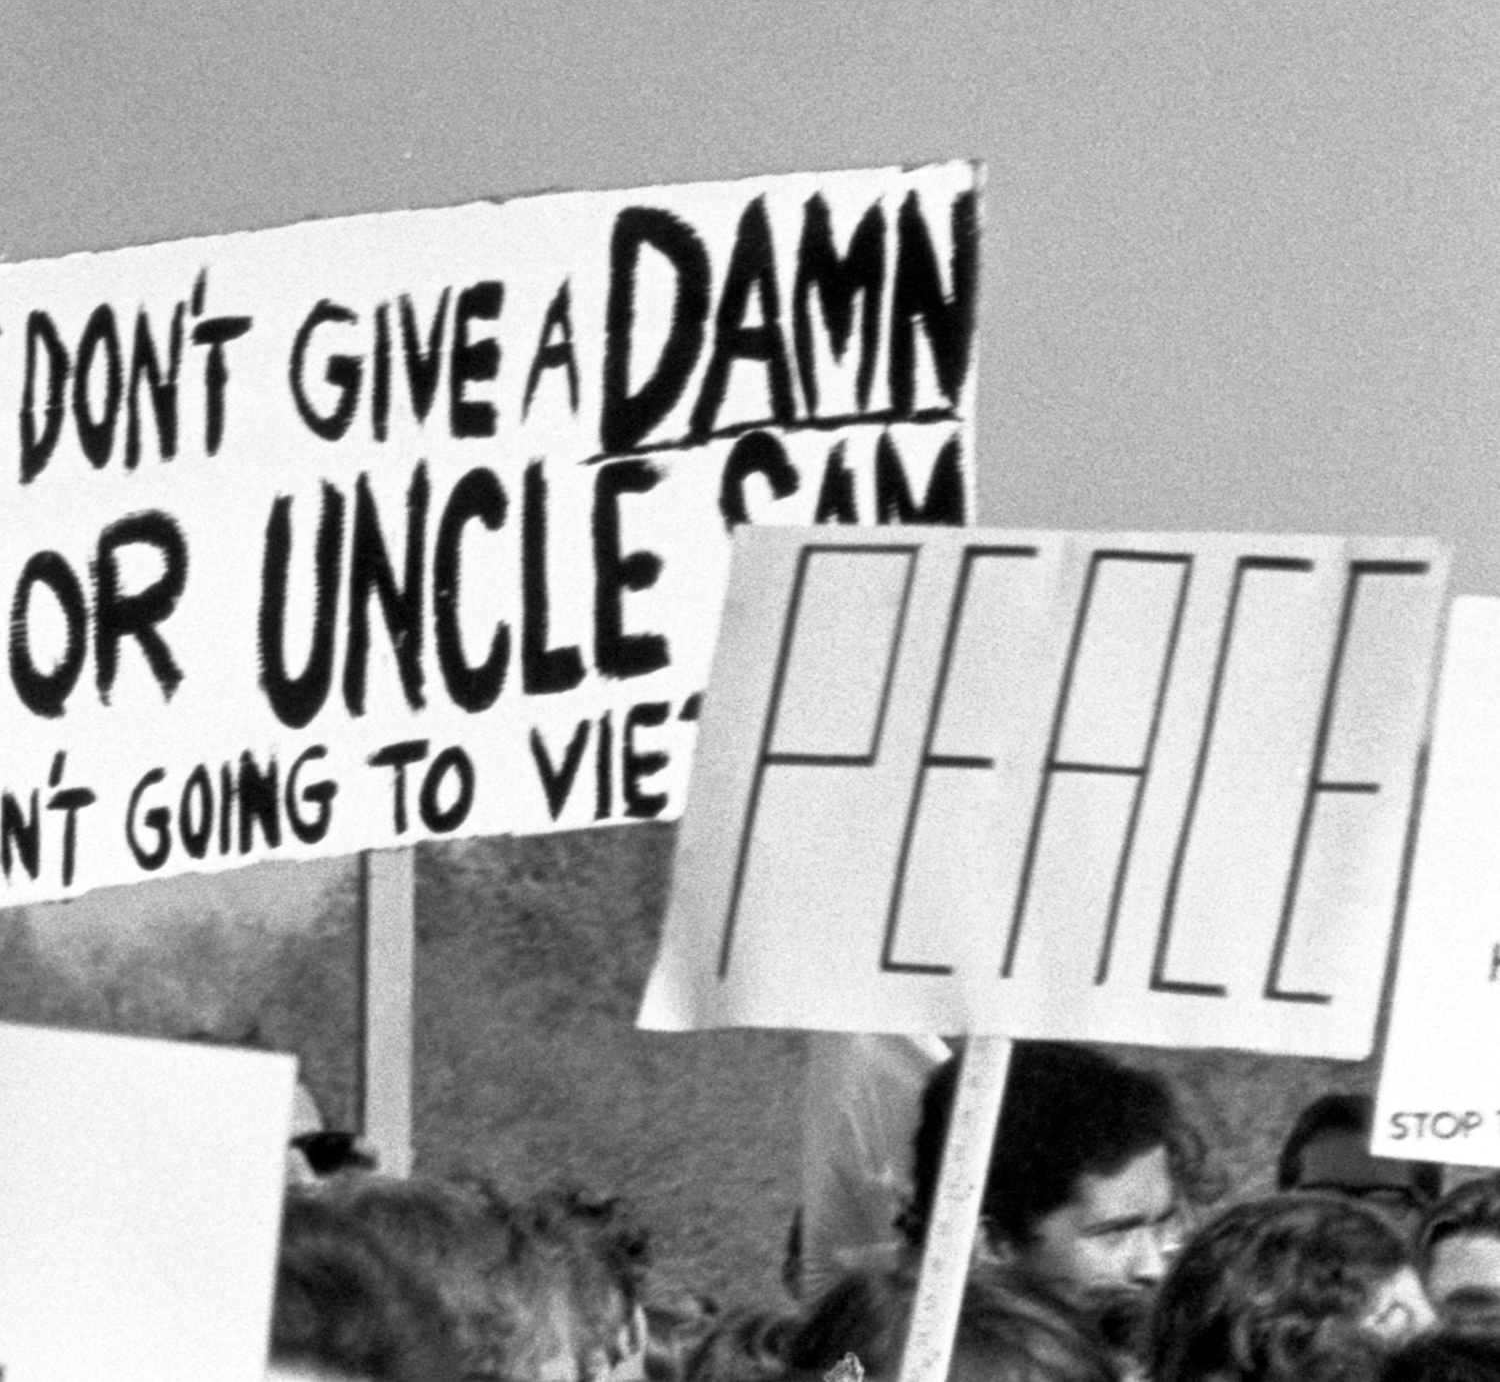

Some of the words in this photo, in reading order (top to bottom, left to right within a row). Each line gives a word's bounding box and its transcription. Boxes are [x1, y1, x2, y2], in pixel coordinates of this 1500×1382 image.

[18, 266, 254, 484] DON'T
[288, 279, 506, 441] GIVE
[522, 276, 580, 424] A
[600, 189, 980, 452] DAMN
[258, 453, 673, 729] UNCLE
[124, 743, 338, 872] GOING
[365, 738, 475, 834] TO
[529, 690, 705, 821] VIE
[717, 541, 1432, 1006] PEACE
[1389, 1110, 1483, 1141] STOP
